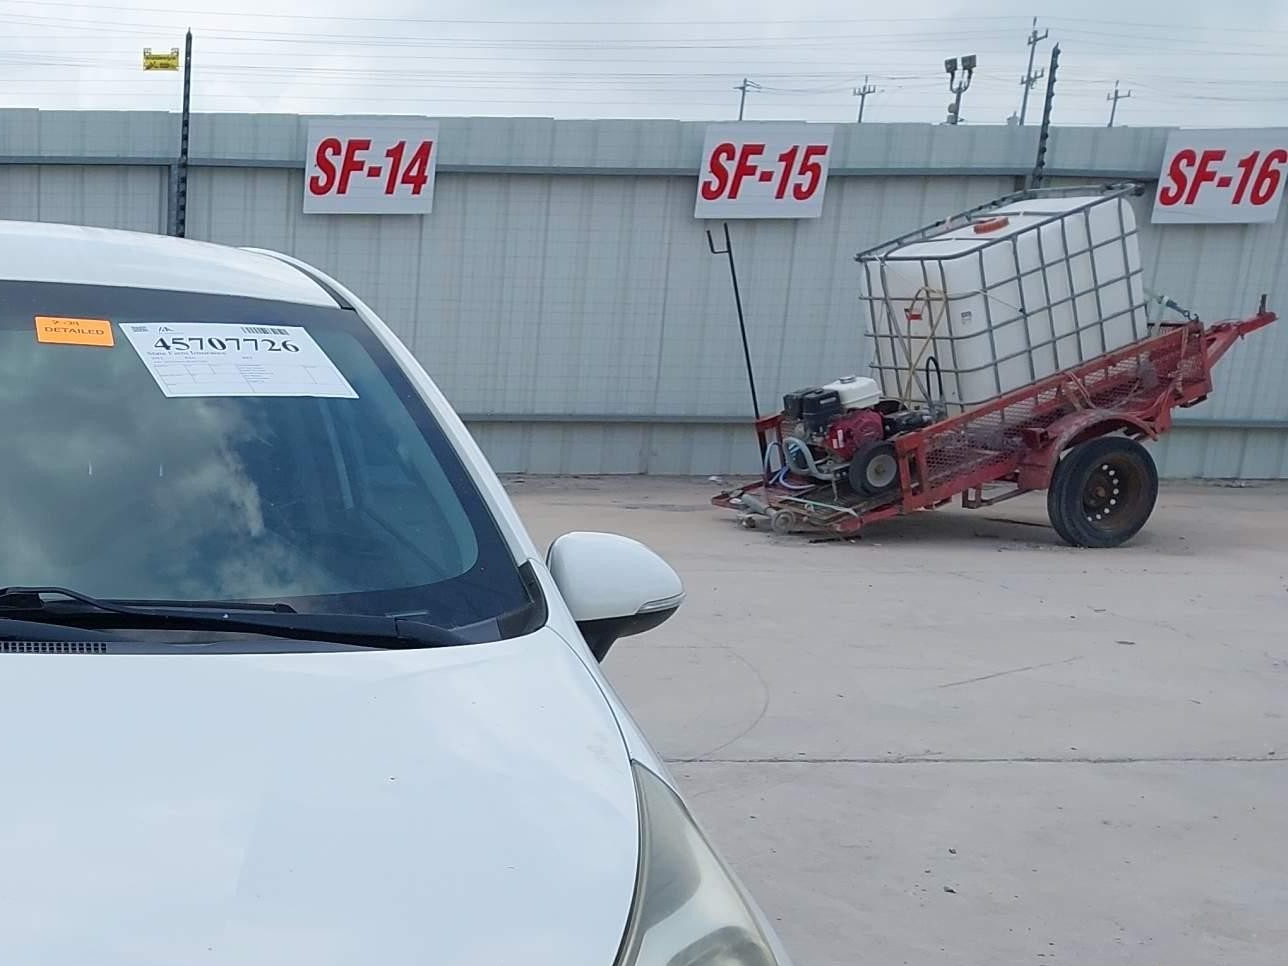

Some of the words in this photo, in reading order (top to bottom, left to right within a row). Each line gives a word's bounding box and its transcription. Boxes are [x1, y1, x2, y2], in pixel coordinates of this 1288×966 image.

[309, 138, 431, 196] SF-14
[700, 142, 829, 201] SF-15
[1159, 149, 1288, 206] SF-16
[43, 326, 105, 336] DETAILED
[154, 337, 300, 353] 45707726
